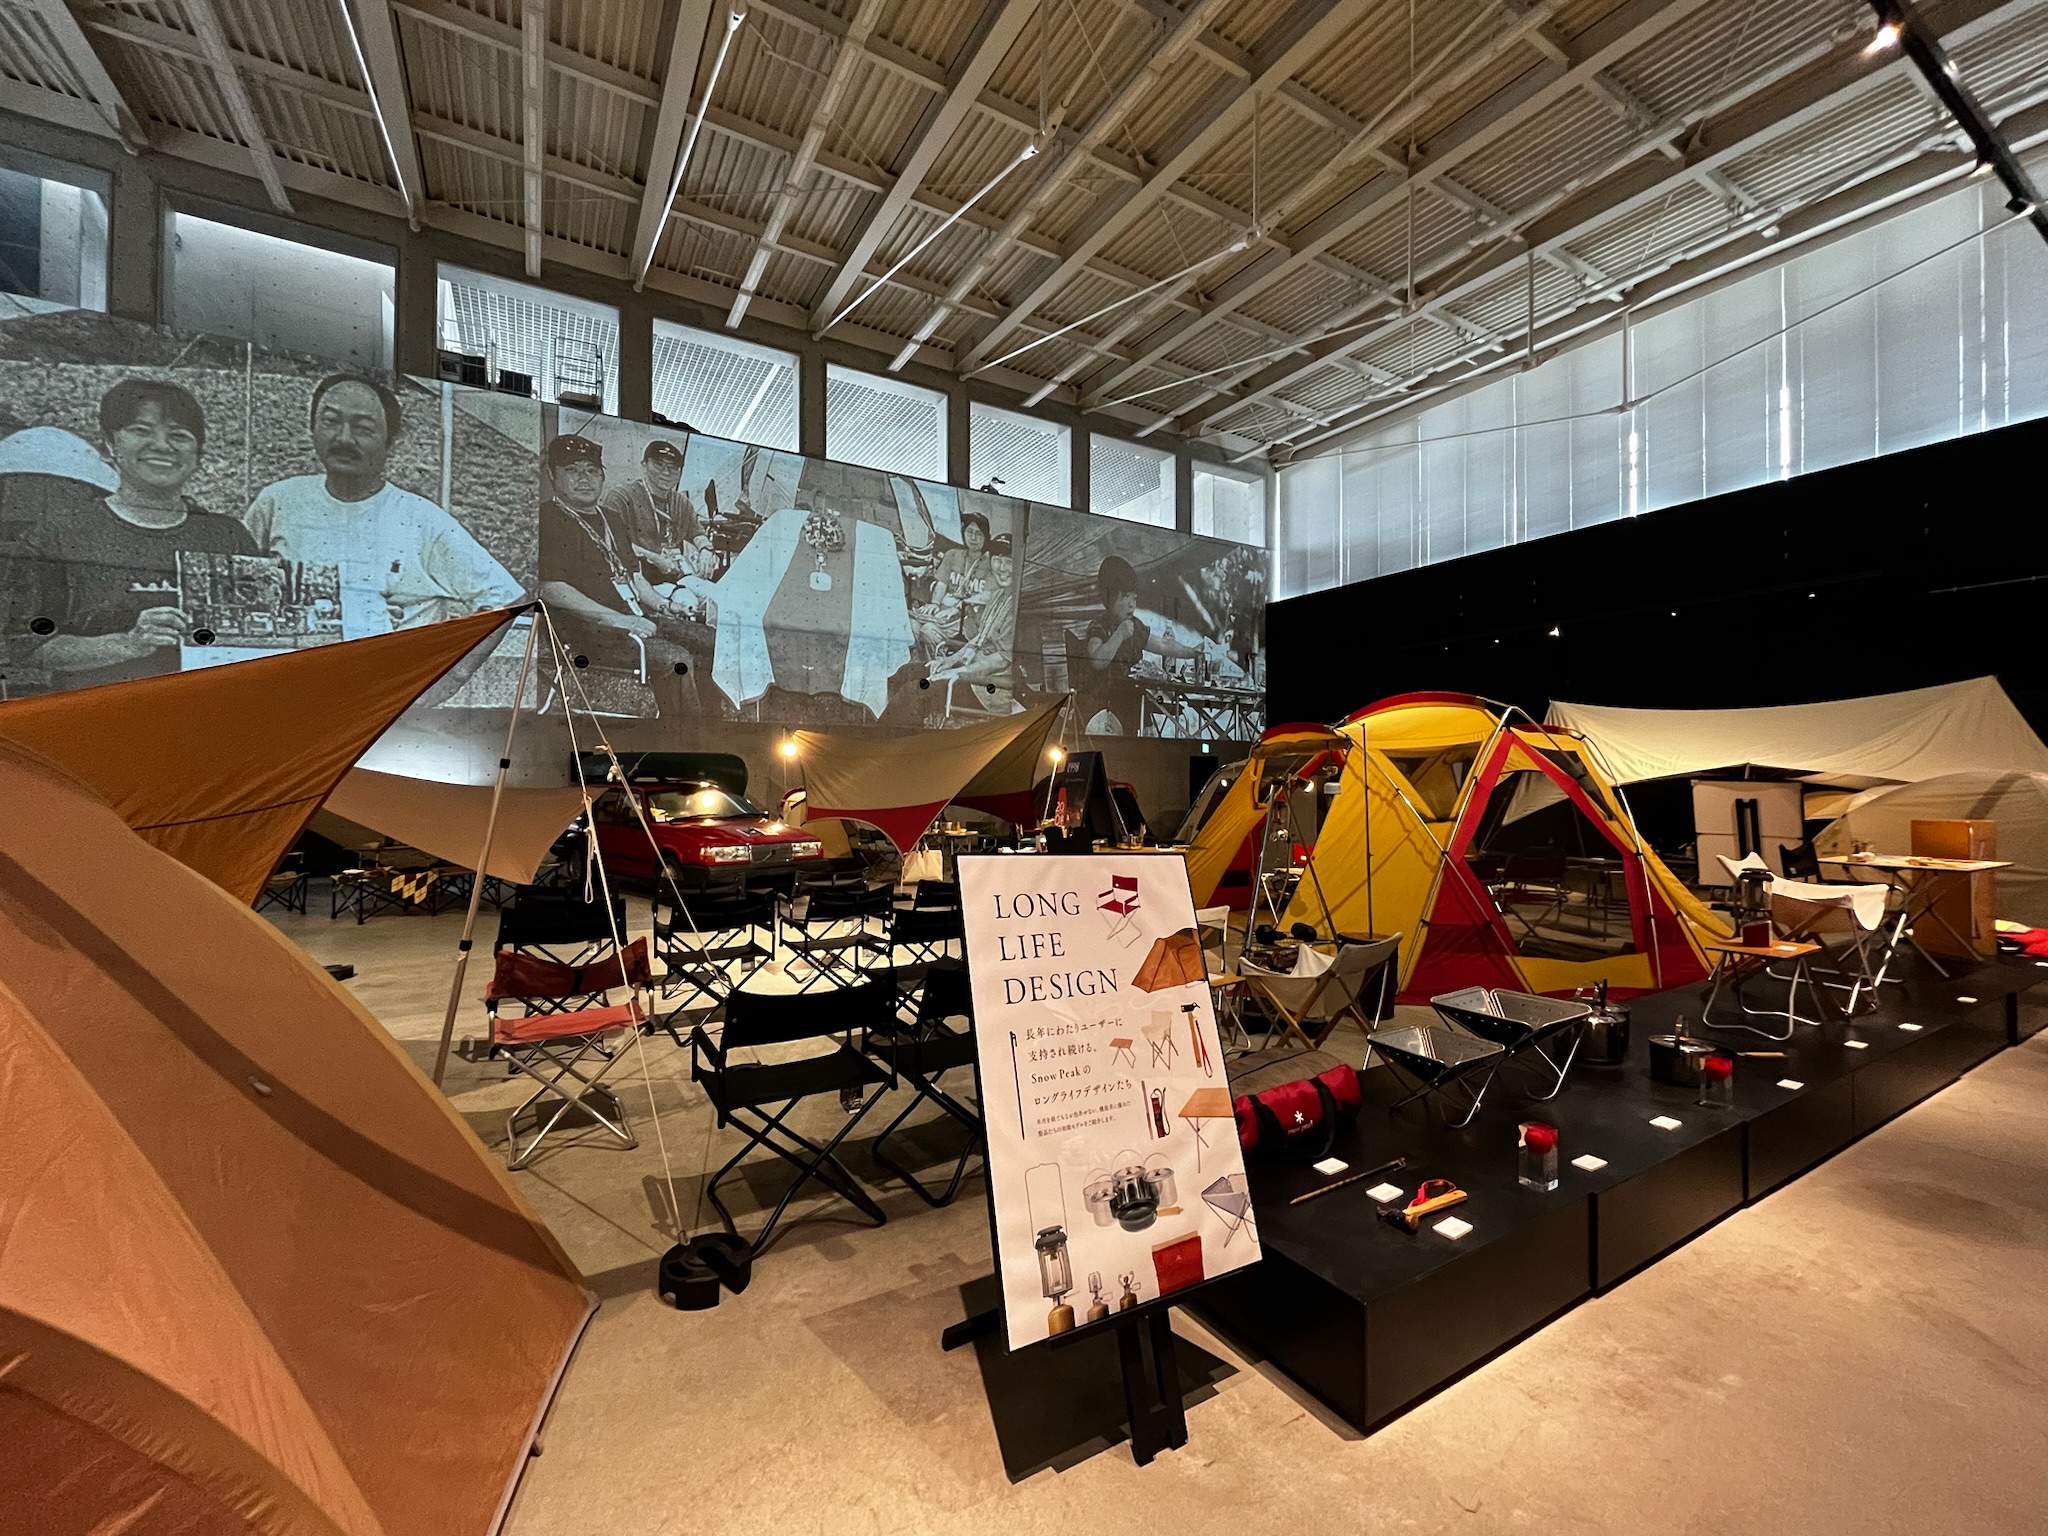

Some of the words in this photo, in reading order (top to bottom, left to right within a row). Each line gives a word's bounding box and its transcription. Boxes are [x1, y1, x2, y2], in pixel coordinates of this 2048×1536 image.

[993, 891, 1080, 919] LONG
[998, 932, 1066, 961] LIFE
[1003, 968, 1118, 1005] DESIGN
[1026, 1018, 1123, 1041] 長年にわたりユーザーに
[1028, 1043, 1097, 1062] 支持され続ける、
[1031, 1073, 1057, 1084] Snow
[1034, 1079, 1132, 1105] ロングライフデザインたち
